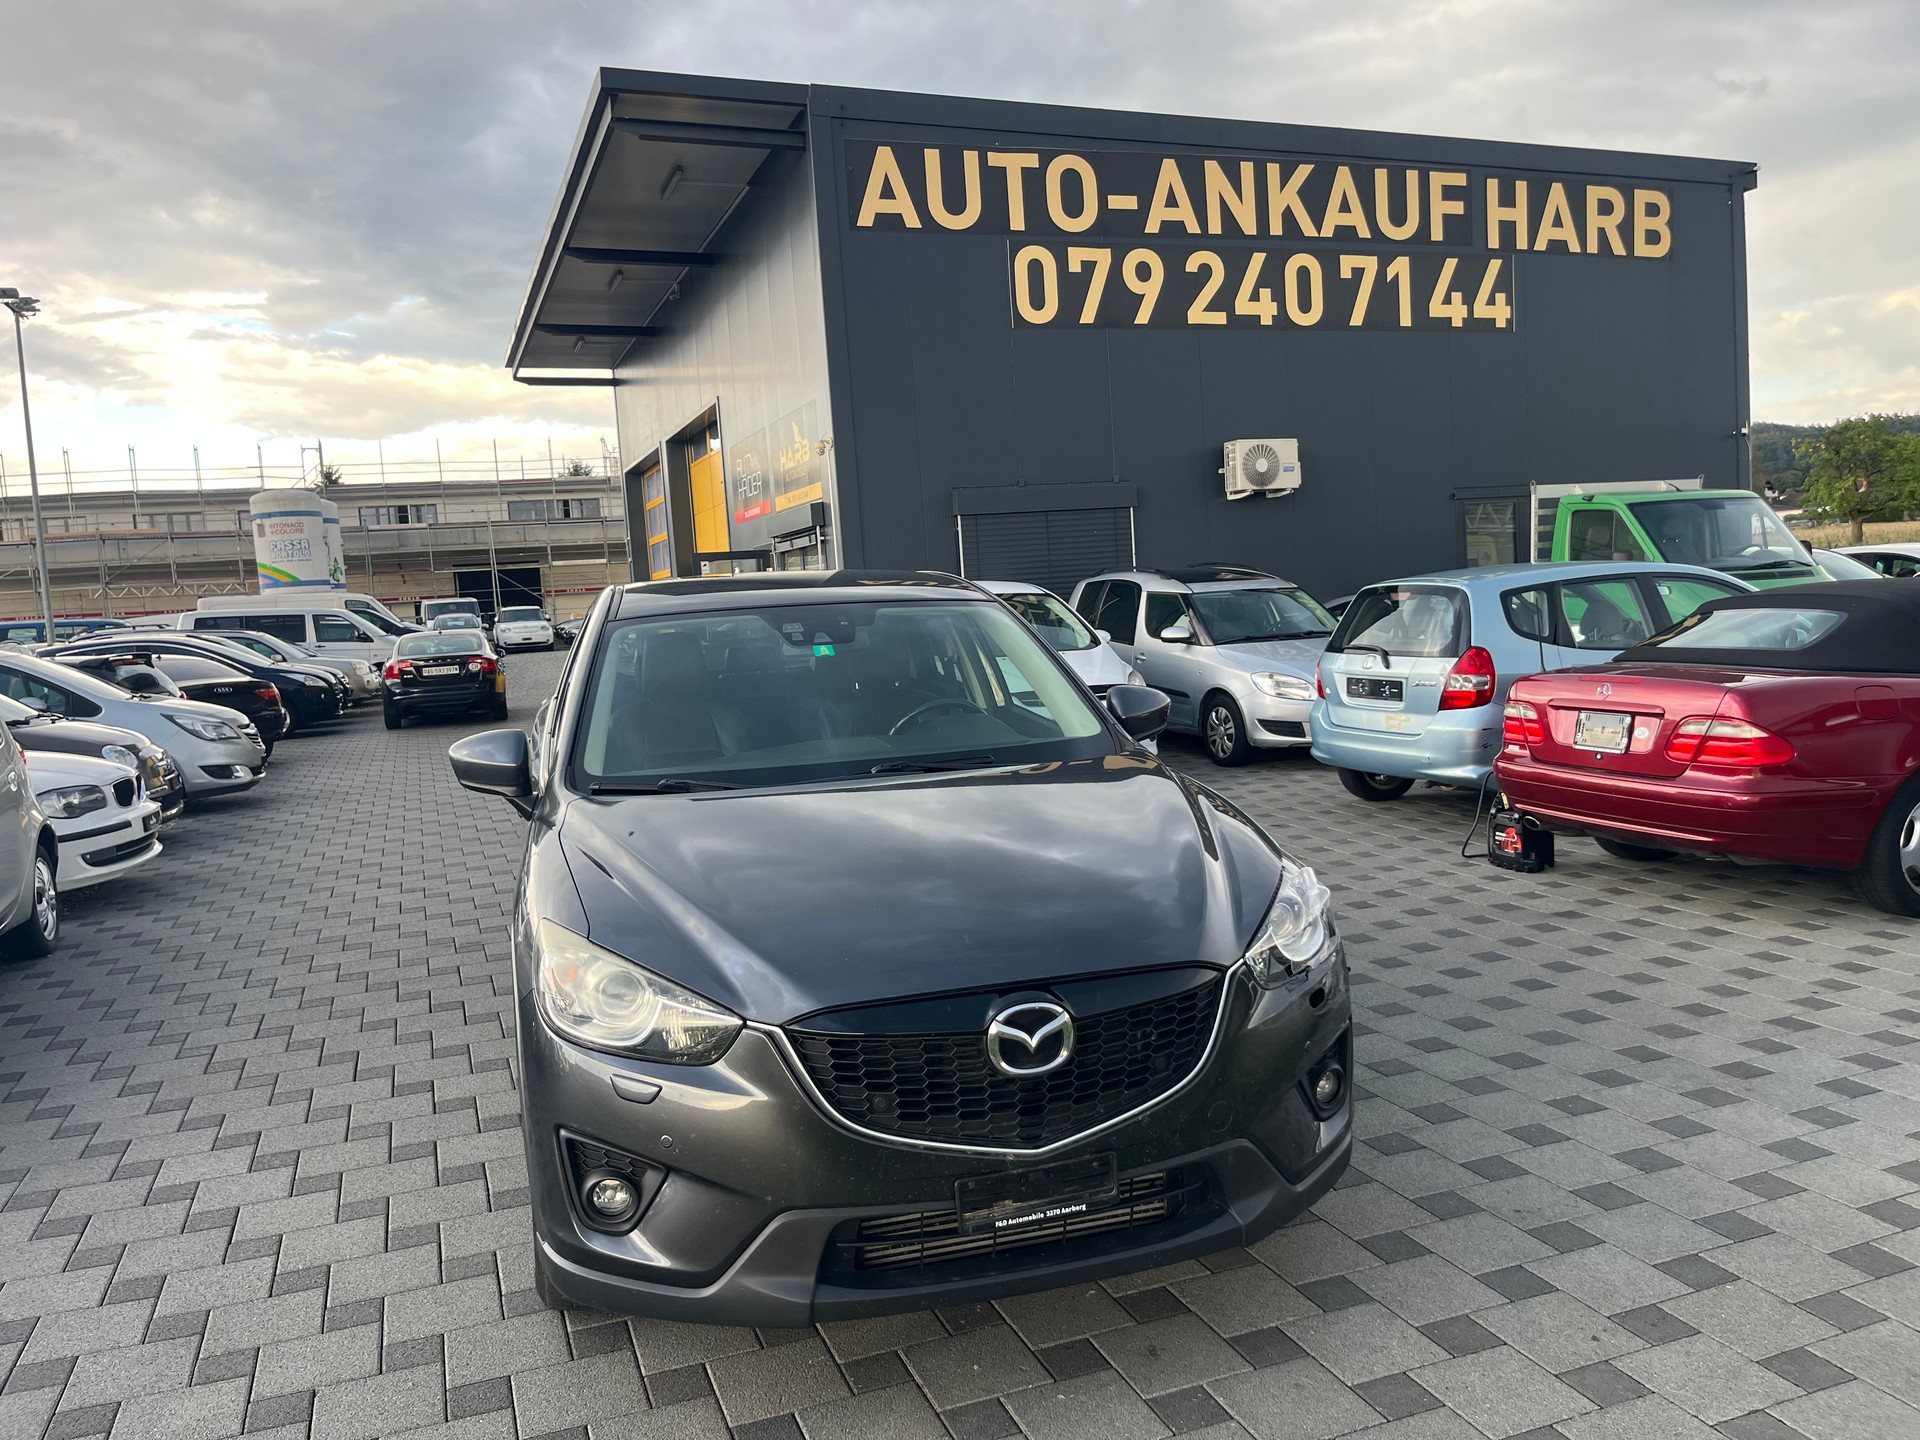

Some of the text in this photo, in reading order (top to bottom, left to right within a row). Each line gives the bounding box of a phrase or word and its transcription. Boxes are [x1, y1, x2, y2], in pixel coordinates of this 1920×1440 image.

[857, 146, 1671, 258] AUTO-ANKAUF HARB
[1014, 245, 1164, 325] 079
[1185, 250, 1323, 326] 240
[780, 438, 809, 471] HARB
[269, 521, 305, 530] INTONACO
[269, 538, 310, 552] FASSA
[1008, 1212, 1044, 1224] Automobile
[1046, 1208, 1060, 1216] 3270
[1061, 1204, 1086, 1213] Aarberg
